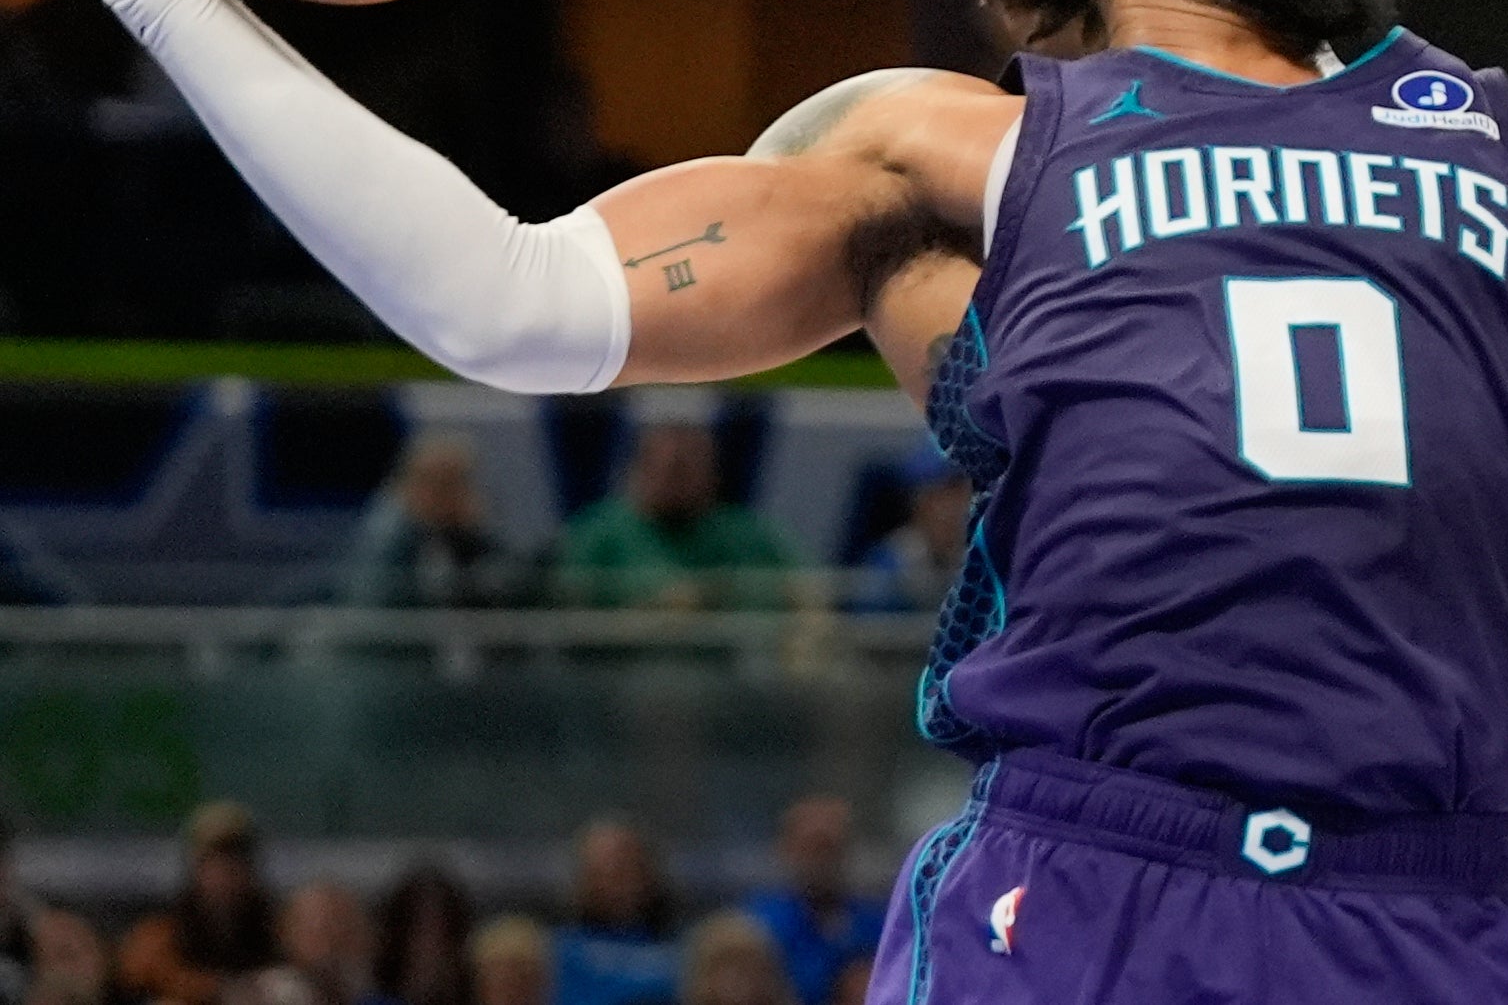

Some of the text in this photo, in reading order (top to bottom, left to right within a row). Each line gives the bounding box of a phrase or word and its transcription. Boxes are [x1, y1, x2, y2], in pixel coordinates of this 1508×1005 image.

[1384, 110, 1498, 134] Judi Health
[1222, 275, 1412, 489] 0
